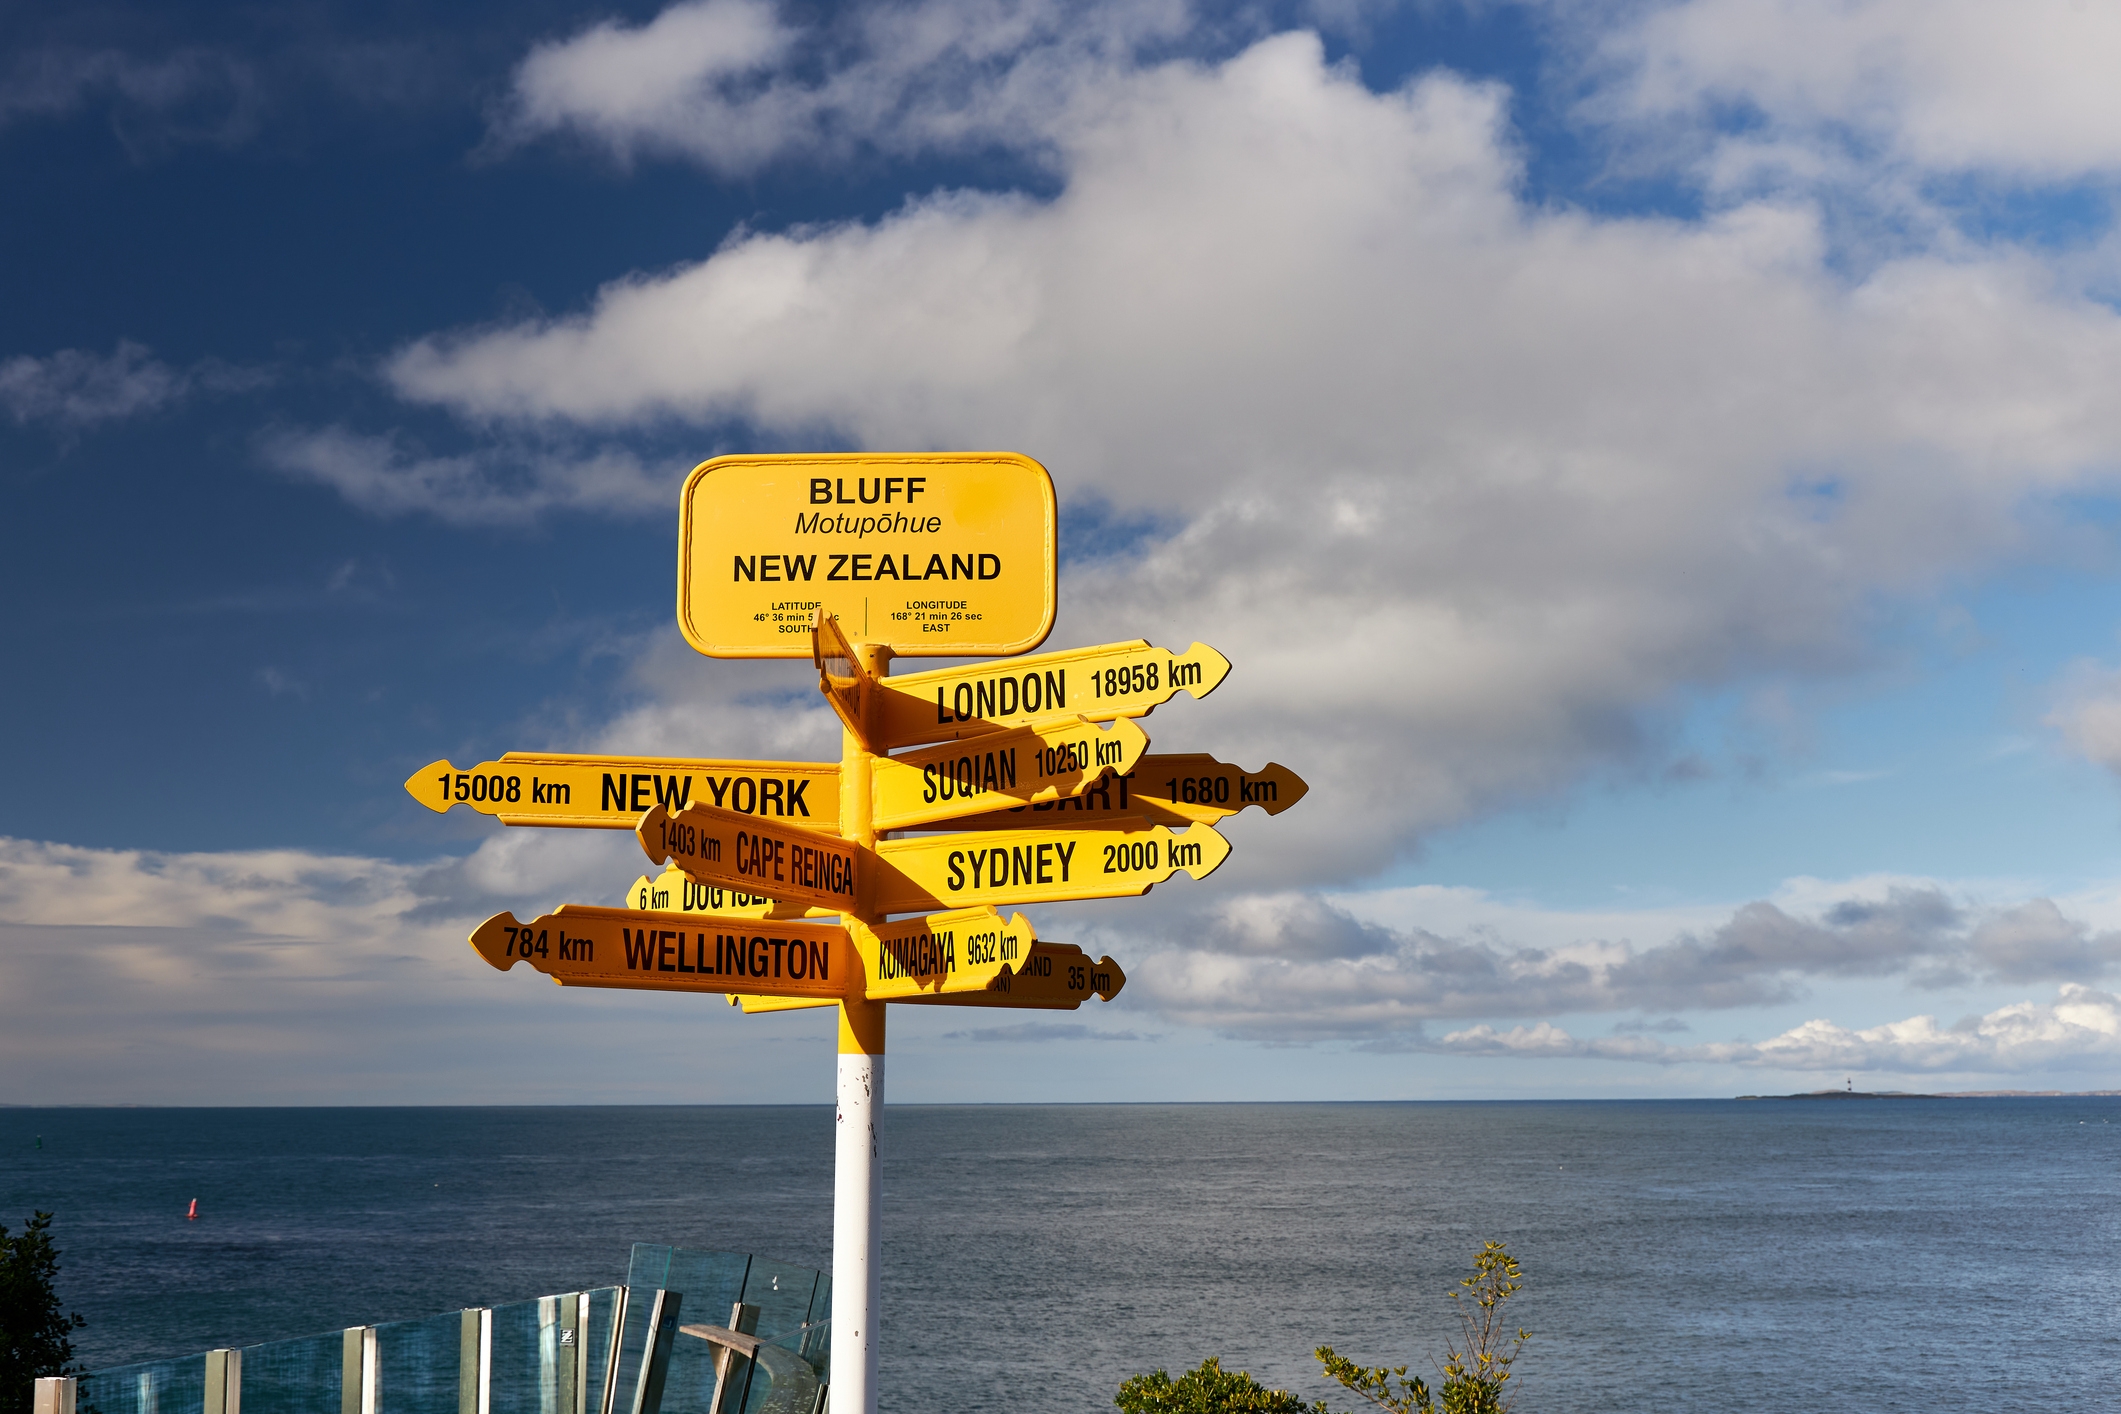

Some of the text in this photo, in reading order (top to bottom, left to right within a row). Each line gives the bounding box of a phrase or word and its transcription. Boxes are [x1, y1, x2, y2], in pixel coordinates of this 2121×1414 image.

[809, 478, 926, 504] BLUFF
[795, 512, 941, 539] Motupōhue
[734, 553, 1001, 581] NEW ZEALAND
[753, 613, 769, 622] 46°
[772, 613, 783, 622] 36
[786, 613, 805, 621] min
[890, 611, 982, 621] 168° 21 min 26 sec
[906, 600, 967, 609] LONGITUDE
[922, 623, 951, 632] EAST
[938, 660, 1202, 723] LONDON 18958 km
[923, 748, 1016, 803] SUQIAN
[1035, 741, 1088, 778] 10250
[1095, 738, 1122, 767] km
[438, 773, 810, 817] 15008 km NEW YORK
[1166, 776, 1229, 804] 1680
[1240, 775, 1278, 802] km
[660, 820, 854, 896] 1403 km CAPE REINGA
[947, 839, 1202, 891] SYDNEY 2000 km
[640, 887, 647, 910] 6
[651, 886, 669, 910] km
[683, 878, 723, 911] DOG
[503, 926, 829, 980] 784 km WELLINGTON
[878, 930, 1018, 980] KUMAGAYA 9632 km
[1067, 966, 1085, 990] 35
[1090, 967, 1111, 992] km
